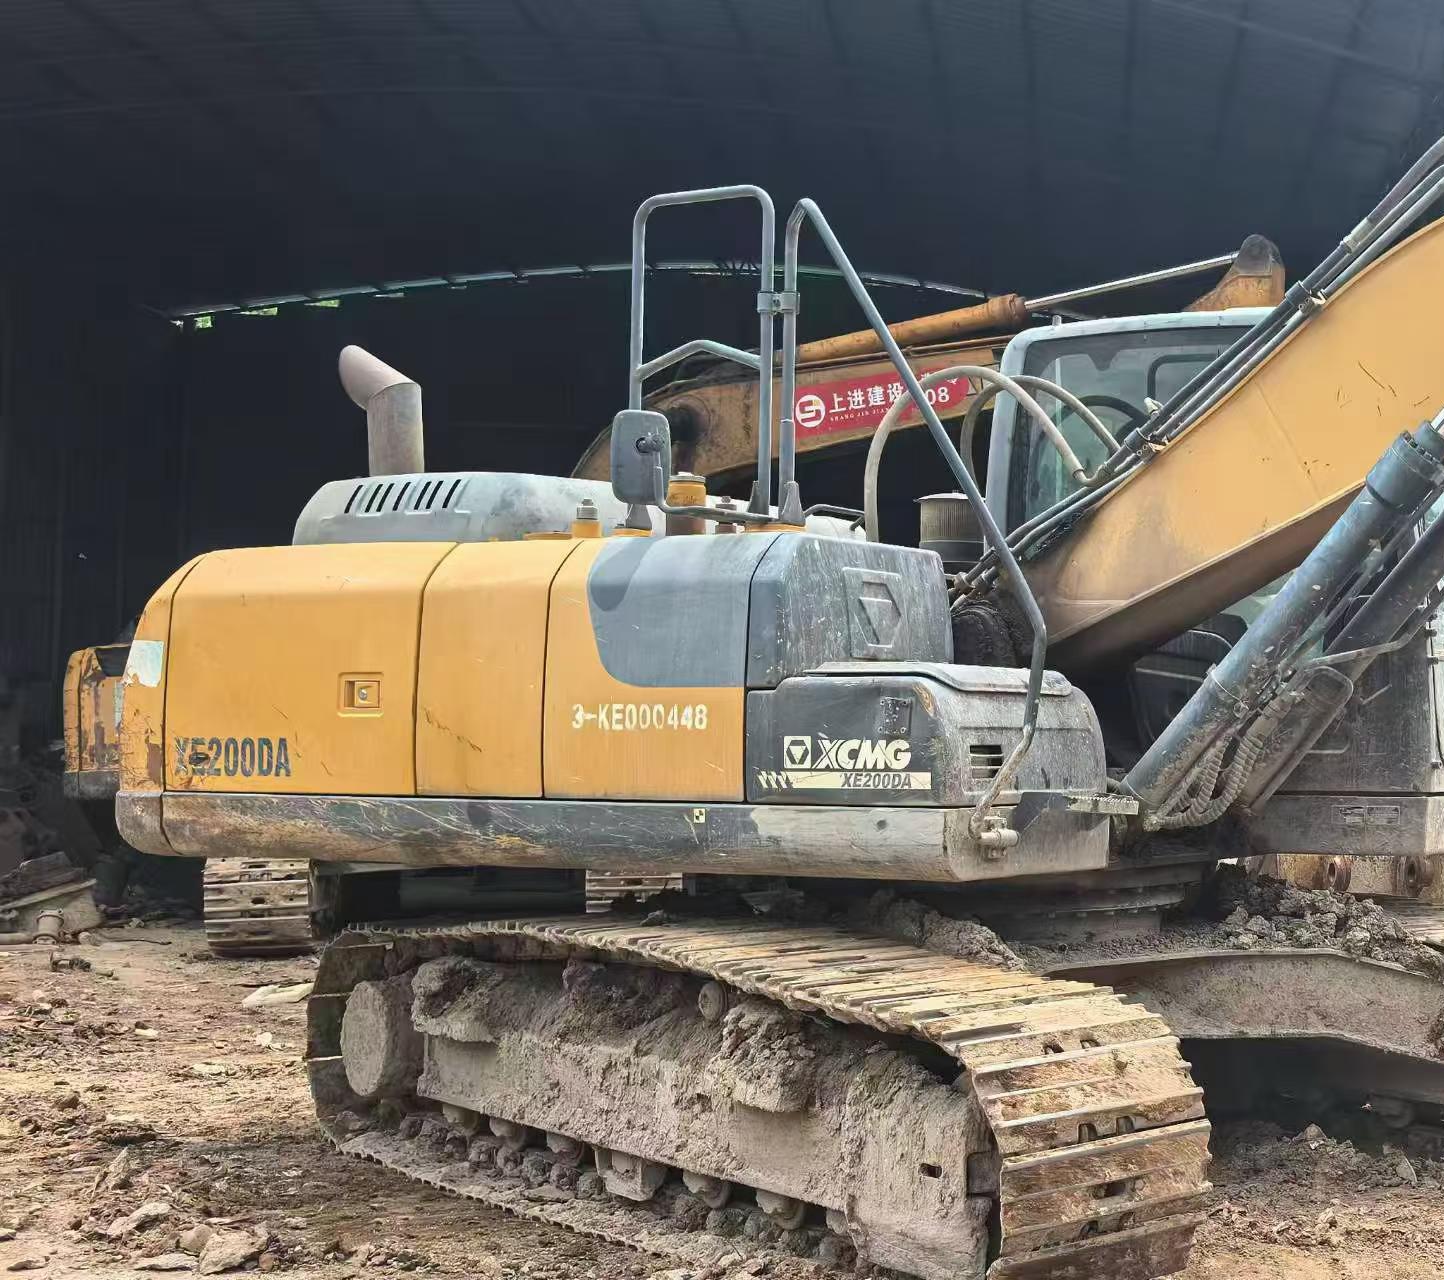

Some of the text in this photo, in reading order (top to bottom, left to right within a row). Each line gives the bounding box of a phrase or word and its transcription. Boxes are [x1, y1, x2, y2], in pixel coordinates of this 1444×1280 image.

[829, 382, 904, 413] 上进建设
[571, 703, 708, 730] 3-KE000448
[174, 736, 291, 777] XE200DA
[812, 739, 912, 769] XCMG
[841, 772, 912, 788] XE200DA
